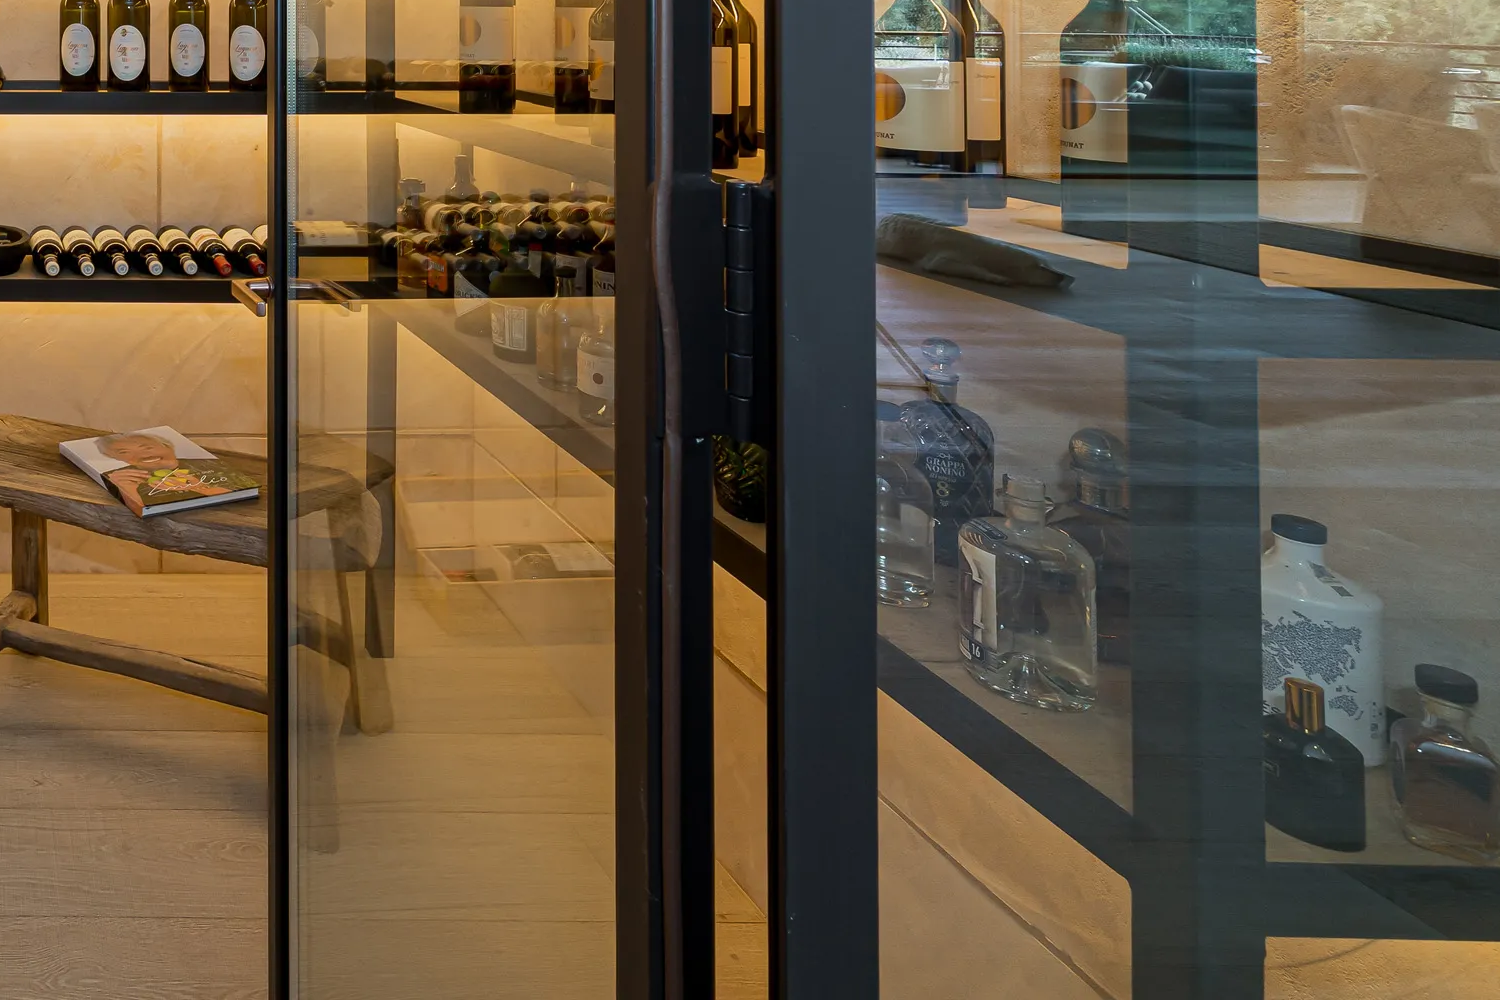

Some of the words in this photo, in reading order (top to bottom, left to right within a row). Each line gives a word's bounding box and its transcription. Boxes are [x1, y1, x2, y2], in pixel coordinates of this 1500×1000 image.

[925, 456, 966, 470] GRAPPA
[925, 463, 966, 478] NONINO
[970, 642, 981, 658] 16
